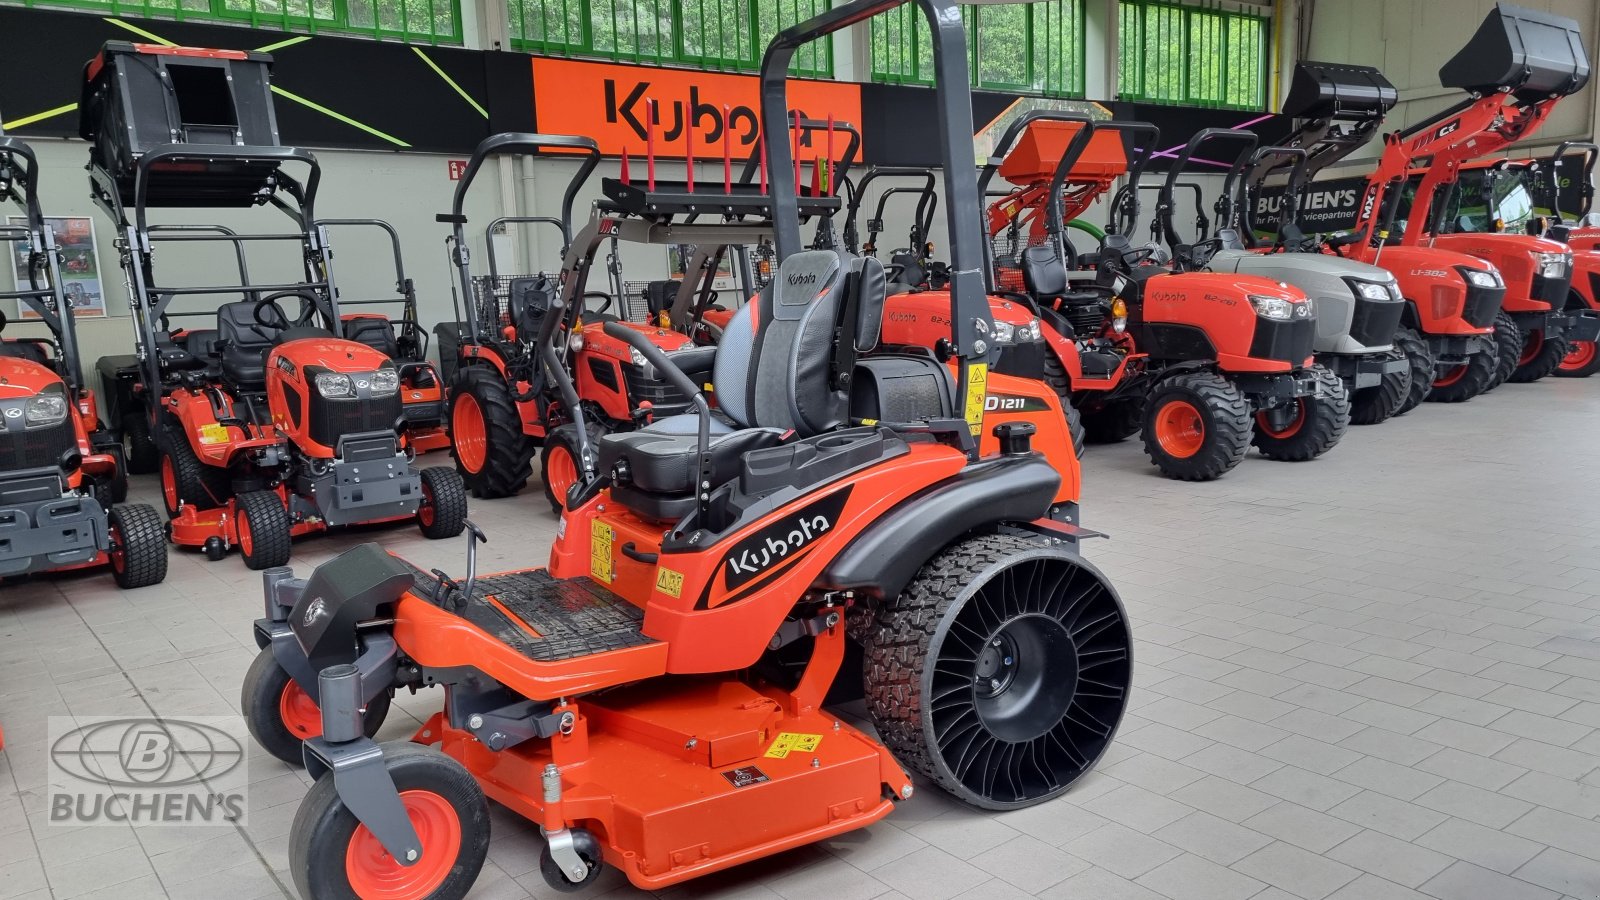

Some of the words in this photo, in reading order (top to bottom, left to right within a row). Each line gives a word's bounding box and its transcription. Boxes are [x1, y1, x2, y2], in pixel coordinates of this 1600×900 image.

[603, 78, 812, 149] Kuboa
[1362, 194, 1375, 219] MX
[787, 271, 816, 286] Kubota
[1152, 290, 1187, 302] Kubota
[888, 311, 917, 322] Kubota
[930, 315, 952, 327] B2-2
[984, 396, 1026, 411] D1211
[729, 515, 830, 575] Kubota
